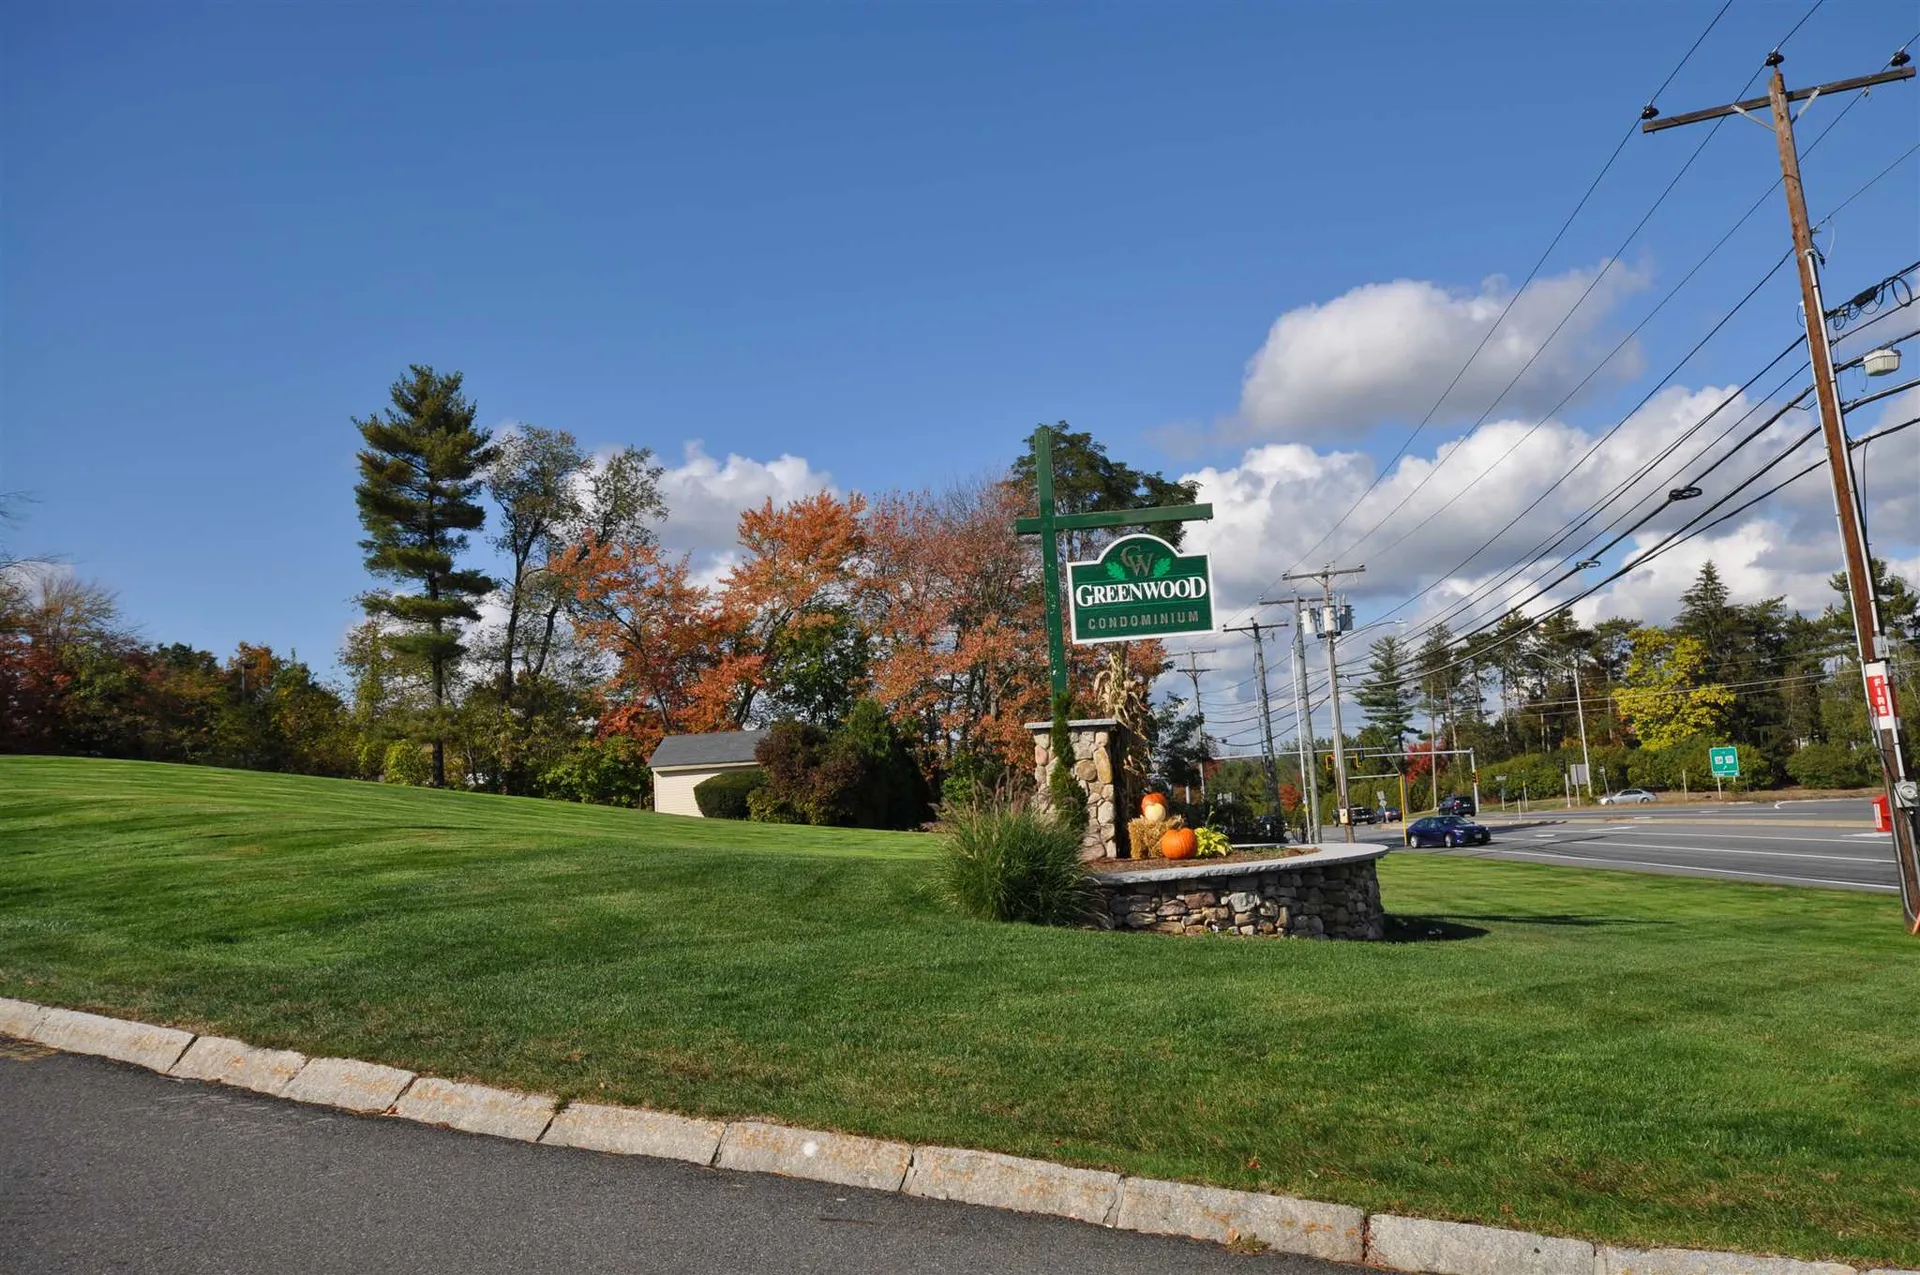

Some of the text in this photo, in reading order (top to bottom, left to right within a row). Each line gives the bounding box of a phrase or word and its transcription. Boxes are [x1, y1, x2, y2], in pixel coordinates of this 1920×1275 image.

[1075, 576, 1207, 607] GREENWOOD
[1088, 610, 1199, 630] CONDOMINIUM
[1873, 678, 1888, 714] FIRE
